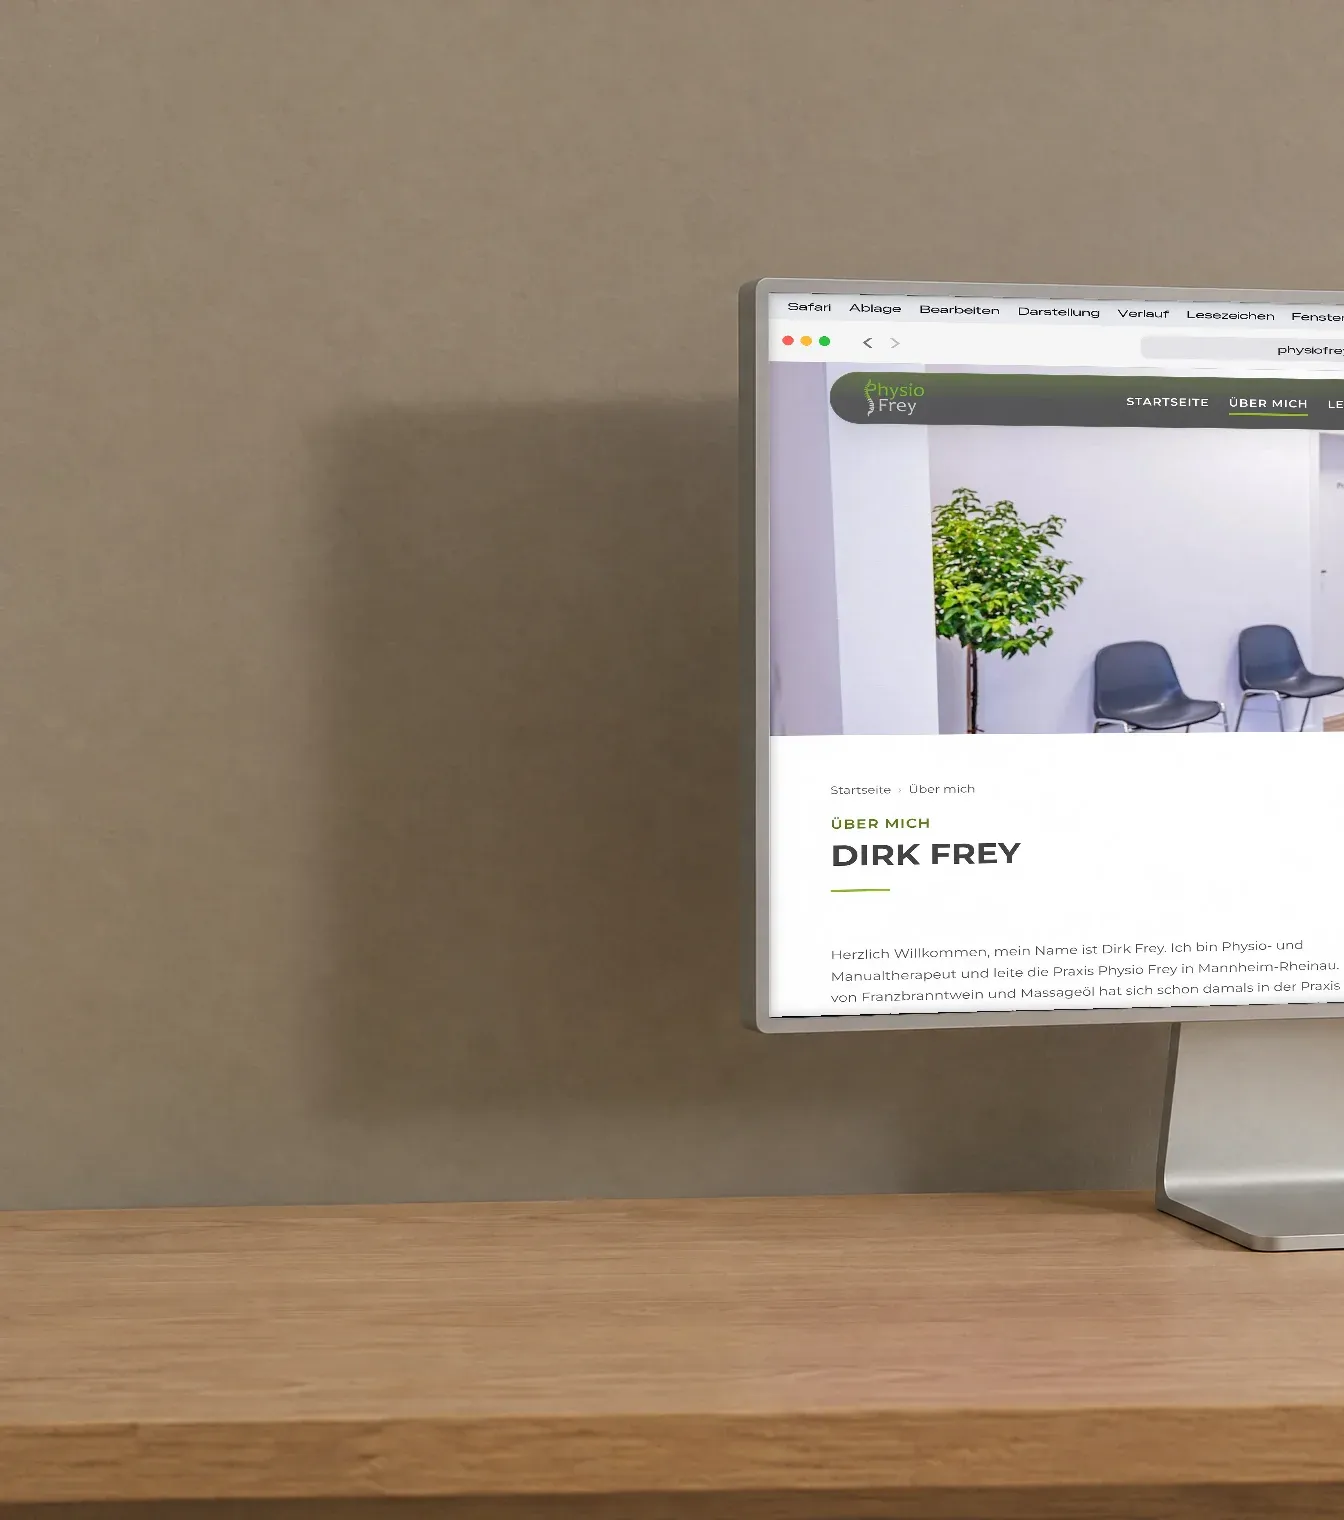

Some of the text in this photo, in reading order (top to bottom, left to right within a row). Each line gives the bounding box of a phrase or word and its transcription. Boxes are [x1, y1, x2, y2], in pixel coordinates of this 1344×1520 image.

[787, 302, 832, 312] Safari
[848, 303, 902, 315] Ablage
[919, 304, 1000, 315] Bearbeiten
[1018, 306, 1100, 319] Darstellung
[1117, 308, 1170, 319] Verlauf
[1186, 310, 1275, 321] Lesezeichen
[864, 379, 924, 400] Physio
[879, 398, 917, 415] Frey
[1126, 396, 1209, 407] STARTSEITE
[1229, 396, 1267, 408] ÜBER
[1272, 399, 1307, 409] MICH
[830, 783, 975, 795] Startseite Über mich
[831, 816, 930, 830] ÜBER MICH
[832, 842, 1022, 867] DIRK FREY
[831, 939, 1303, 960] Herzlich Willkommen, mein Name ist Dirk Frey. Ich bin Physio- und
[831, 969, 957, 982] Manualtherapeut
[961, 967, 989, 979] und
[993, 967, 1024, 978] leite
[1027, 966, 1049, 978] die
[1053, 965, 1095, 977] Praxis
[1098, 964, 1144, 978] Physio
[1148, 964, 1178, 977] Frey
[1181, 963, 1194, 974] in
[1198, 960, 1340, 974] Mannheim-Rheinau.
[830, 994, 857, 1003] von
[862, 989, 984, 1002] Franzbranntwein
[988, 987, 1016, 999] und
[1021, 986, 1095, 1000] Massageöl
[1099, 985, 1123, 997] hat
[1125, 984, 1153, 996] sich
[1157, 984, 1199, 995] schon
[1202, 982, 1254, 994] damals
[1257, 982, 1270, 993] in
[1273, 981, 1297, 992] der
[1301, 980, 1341, 992] Praxis
